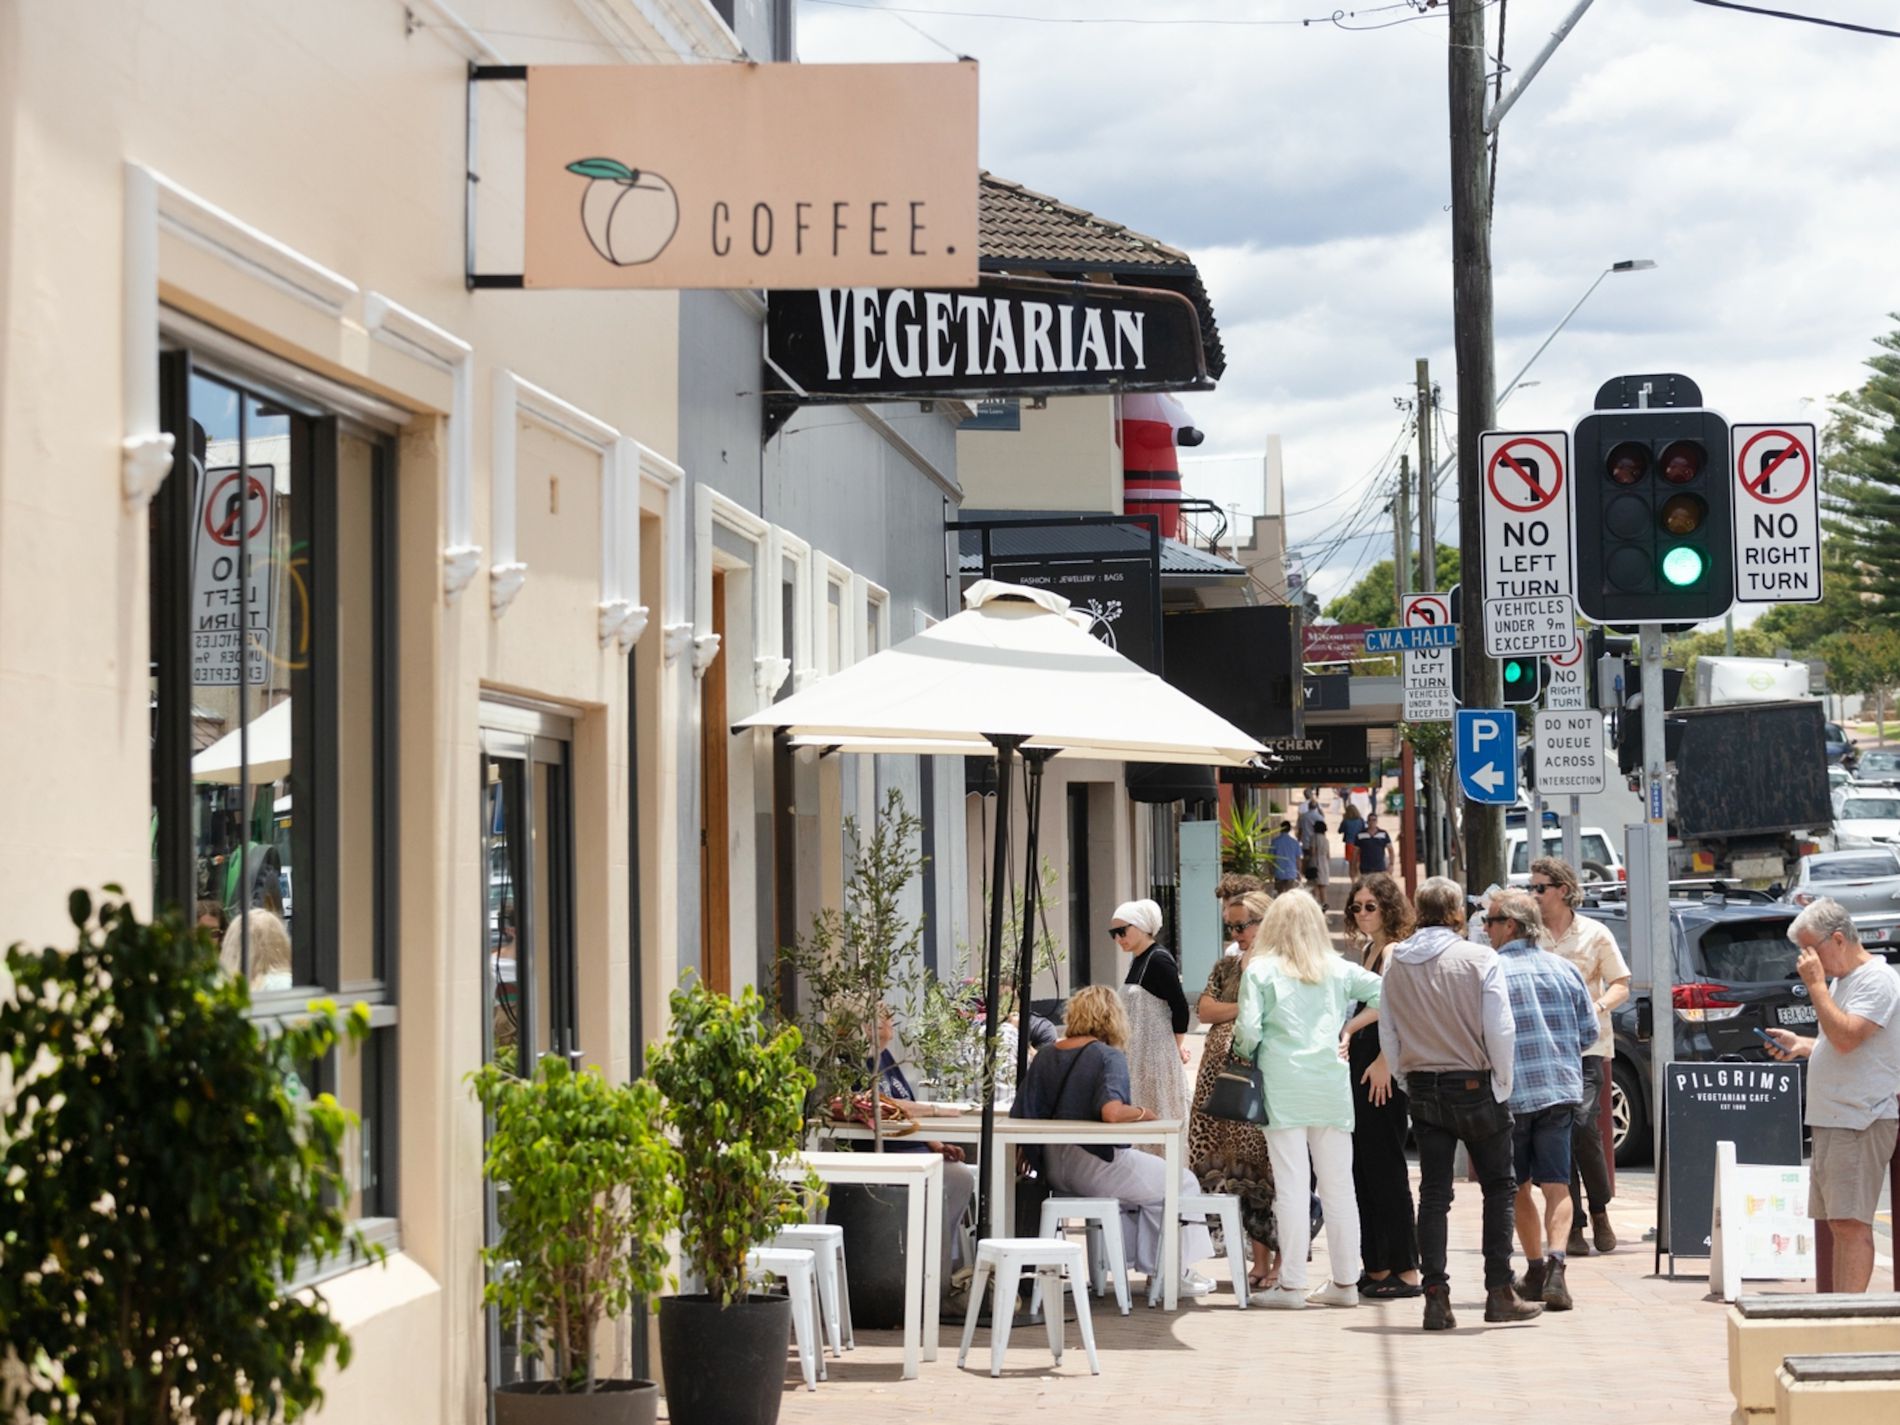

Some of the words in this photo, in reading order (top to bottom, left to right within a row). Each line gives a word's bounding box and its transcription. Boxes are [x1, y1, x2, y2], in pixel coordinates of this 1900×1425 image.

[712, 201, 956, 257] COFFEE.
[818, 287, 1147, 381] VEGETARIAN
[1754, 513, 1798, 539] NO
[1503, 520, 1549, 548] NO
[1745, 546, 1811, 565] RIGHT
[1499, 554, 1557, 573] LEFT
[1019, 576, 1051, 585] FASHION
[1059, 574, 1096, 584] JEWELLERY
[1104, 572, 1125, 582] BAGS
[1747, 572, 1809, 590] TURN
[1496, 579, 1559, 597] TURN
[1494, 600, 1564, 617] VEHICLES
[1494, 619, 1535, 633] UNDER
[1546, 617, 1566, 631] 9m
[1365, 631, 1409, 651] C.W.A.
[1411, 627, 1454, 647] HALL
[1495, 634, 1567, 652] EXCEPTED
[1414, 647, 1441, 659] NO
[1412, 662, 1445, 674] LEFT
[1554, 670, 1577, 682] NO
[1411, 677, 1447, 688] TURN
[1408, 689, 1449, 699] VEHICLES
[1550, 686, 1582, 696] RIGHT
[1408, 700, 1432, 708] UNDER
[1552, 698, 1582, 708] TURN
[1408, 708, 1450, 719] EXCEPTED
[1545, 719, 1562, 730] DO
[1568, 718, 1593, 730] NOT
[1472, 718, 1500, 753] P
[1265, 739, 1324, 751] TCHERY
[1547, 737, 1592, 749] QUEUE
[1545, 755, 1596, 767] ACROSS
[1327, 766, 1365, 775] BAKERY
[1538, 775, 1602, 787] INTERSECTION
[1676, 1069, 1790, 1093] PILGRIMS
[1696, 1092, 1747, 1102] VEGETARIAN
[1749, 1093, 1770, 1103] CAFE
